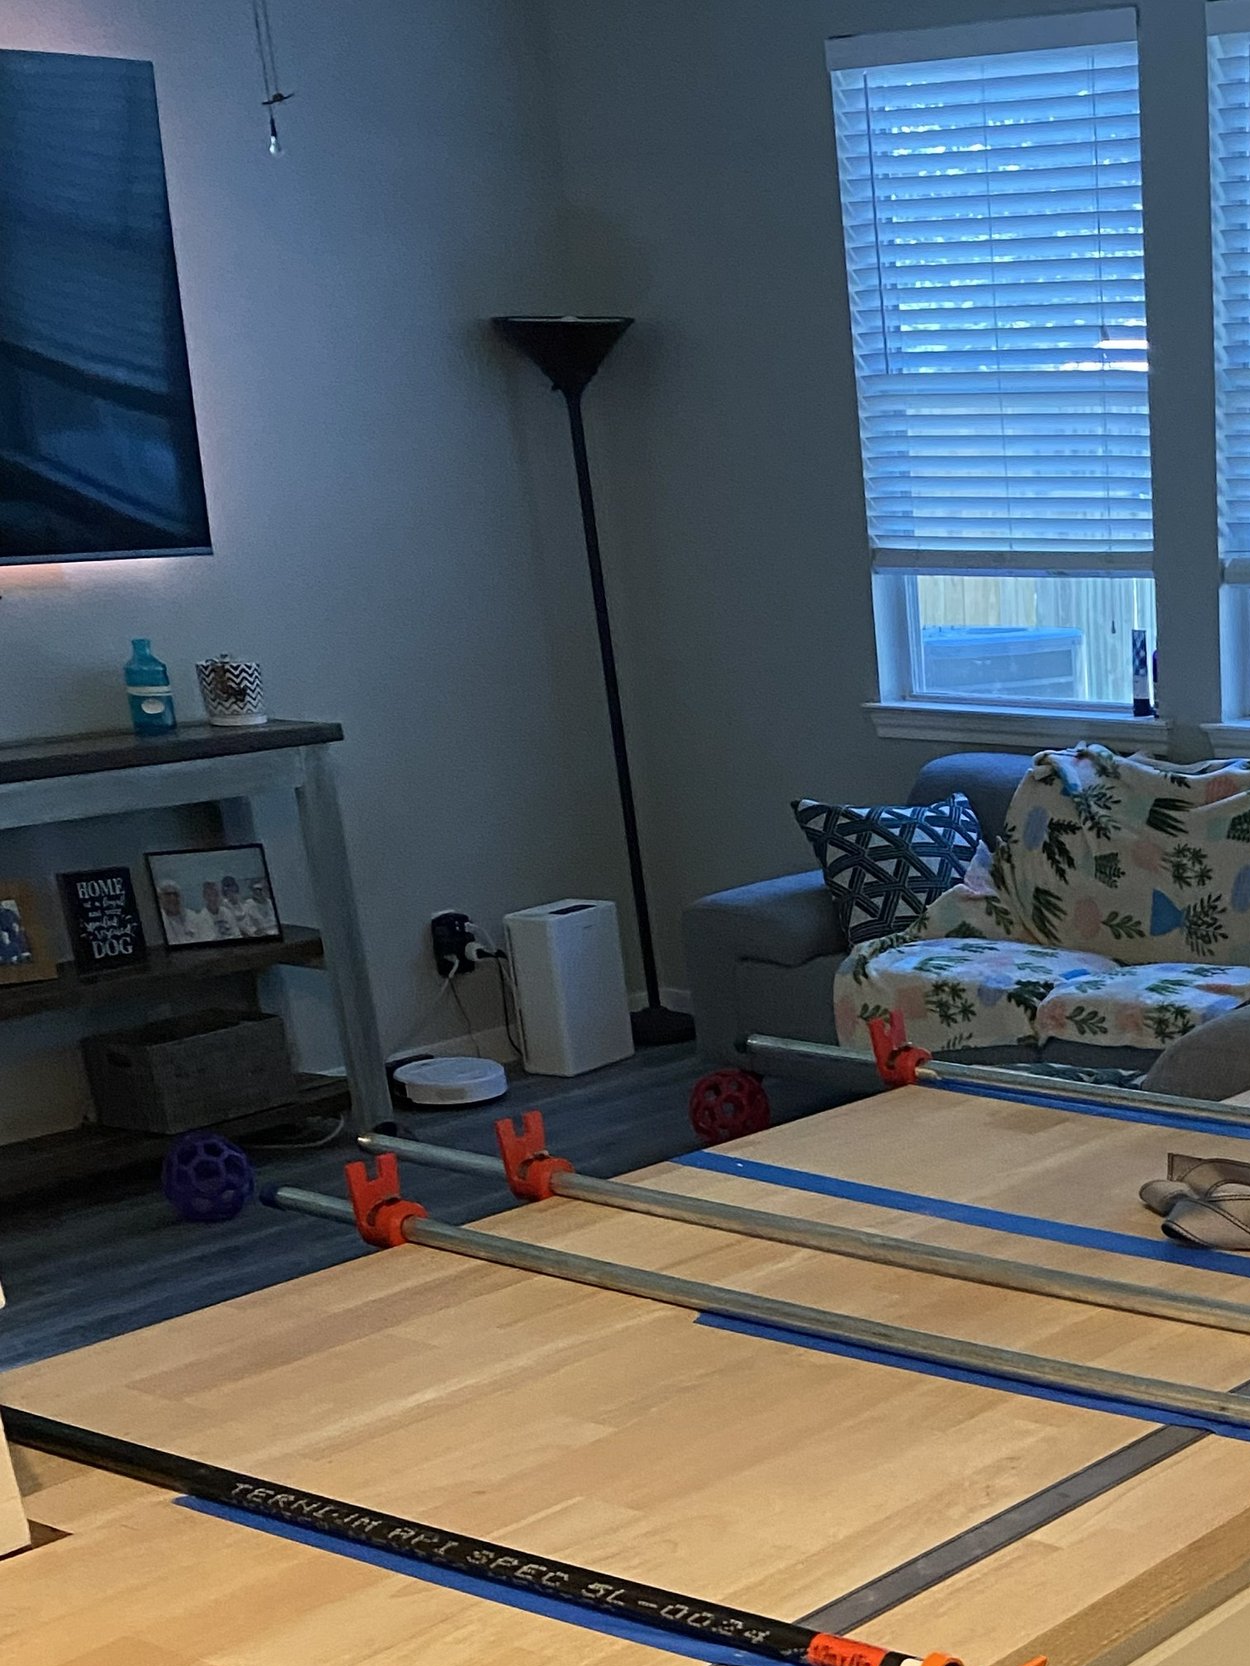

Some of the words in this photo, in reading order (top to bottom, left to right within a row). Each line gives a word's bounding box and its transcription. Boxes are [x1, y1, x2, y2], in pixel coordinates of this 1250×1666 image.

[76, 877, 125, 899] HOME
[92, 937, 133, 959] DOG
[388, 1526, 459, 1555] API
[466, 1549, 569, 1587] SPEC
